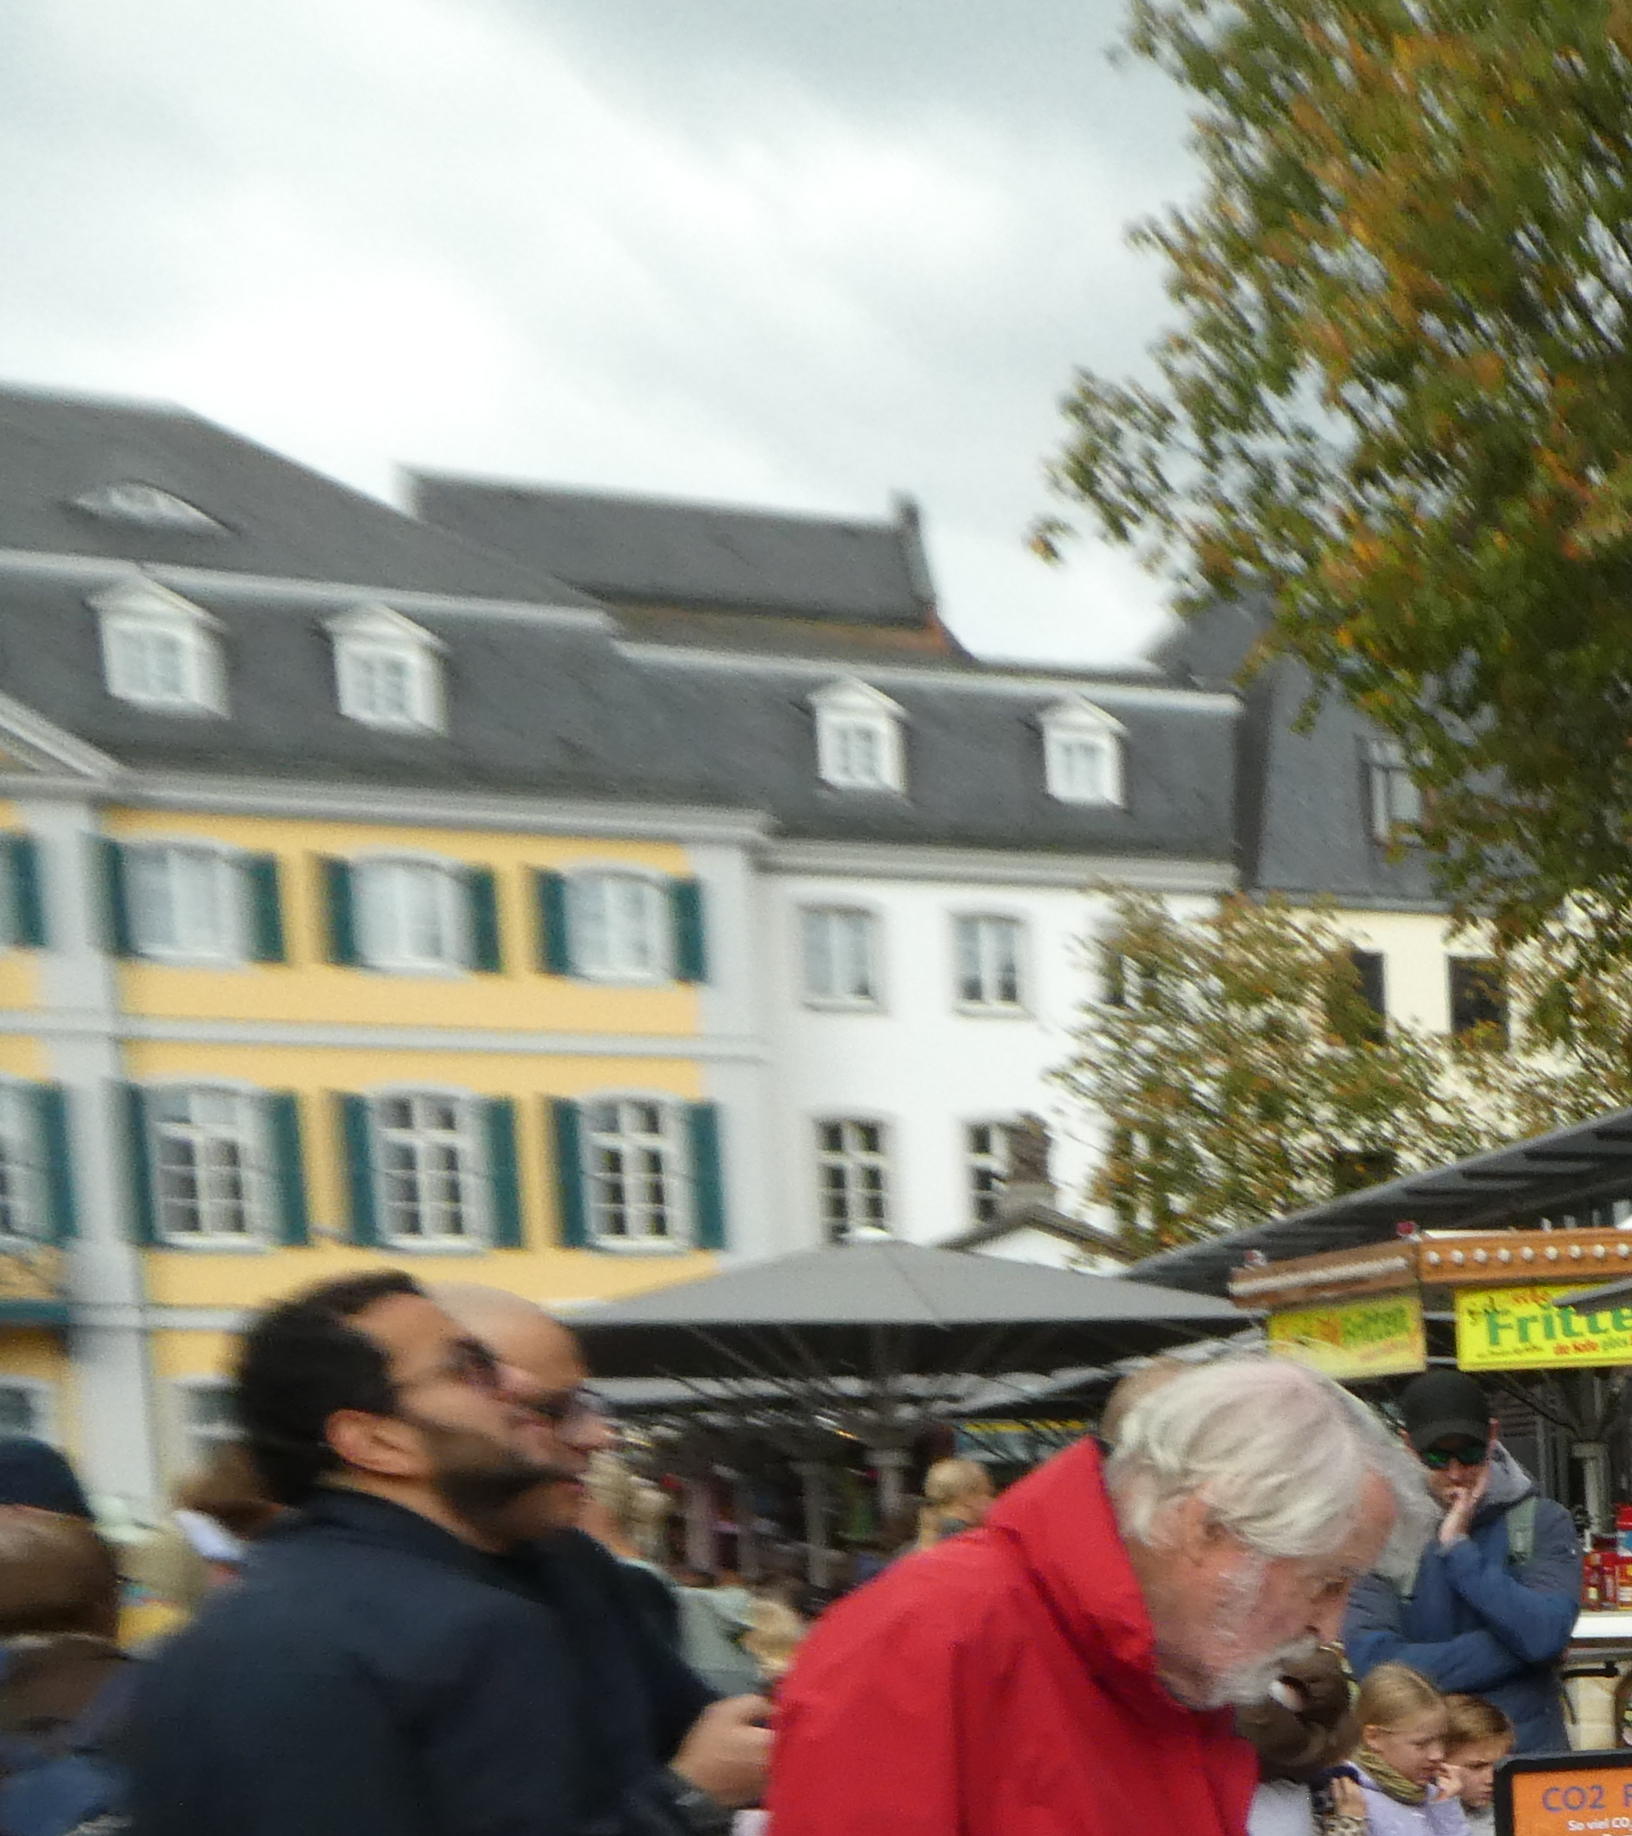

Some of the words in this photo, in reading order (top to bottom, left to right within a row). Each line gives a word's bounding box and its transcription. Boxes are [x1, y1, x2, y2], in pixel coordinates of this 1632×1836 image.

[1543, 1784, 1606, 1812] CO2
[1568, 1820, 1585, 1832] So
[1587, 1818, 1609, 1830] viel
